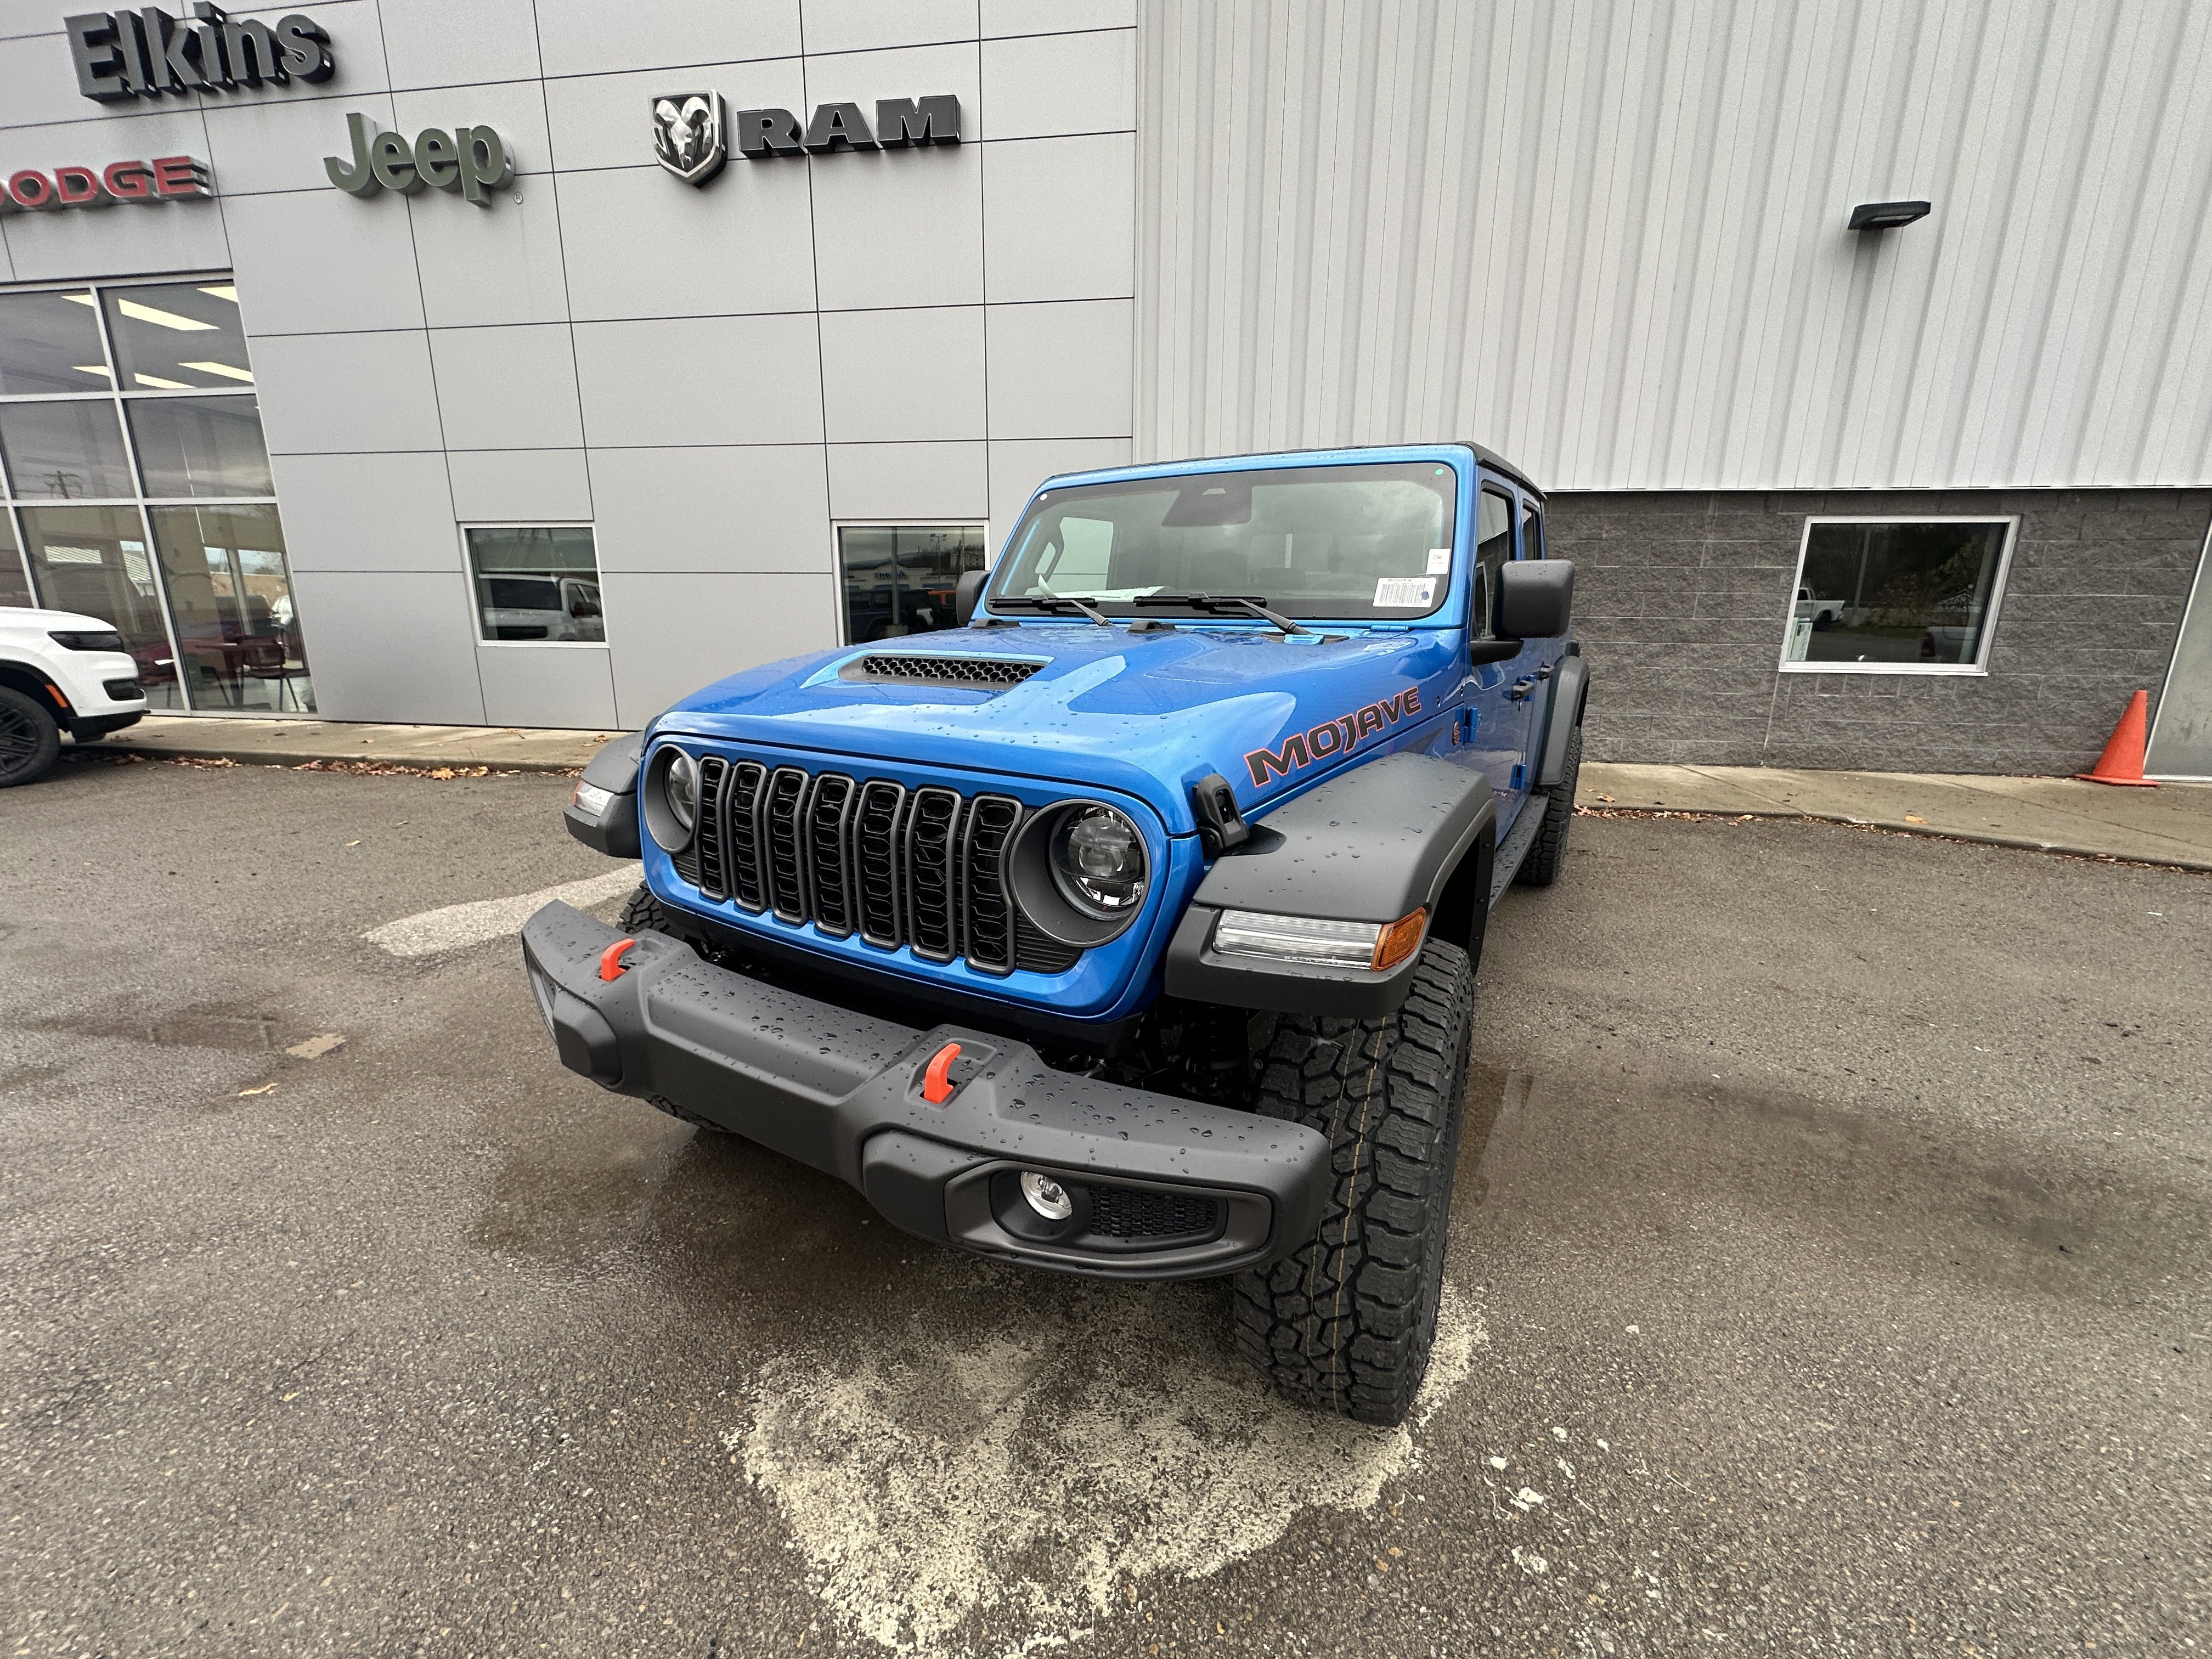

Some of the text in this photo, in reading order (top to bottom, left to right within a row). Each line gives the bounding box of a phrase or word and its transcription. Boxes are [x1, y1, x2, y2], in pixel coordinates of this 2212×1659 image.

[64, 2, 329, 99] Elkins
[324, 112, 507, 204] Jeep
[736, 95, 959, 154] RAM
[0, 156, 203, 206] ODGE
[1243, 686, 1422, 788] MOJAVE
